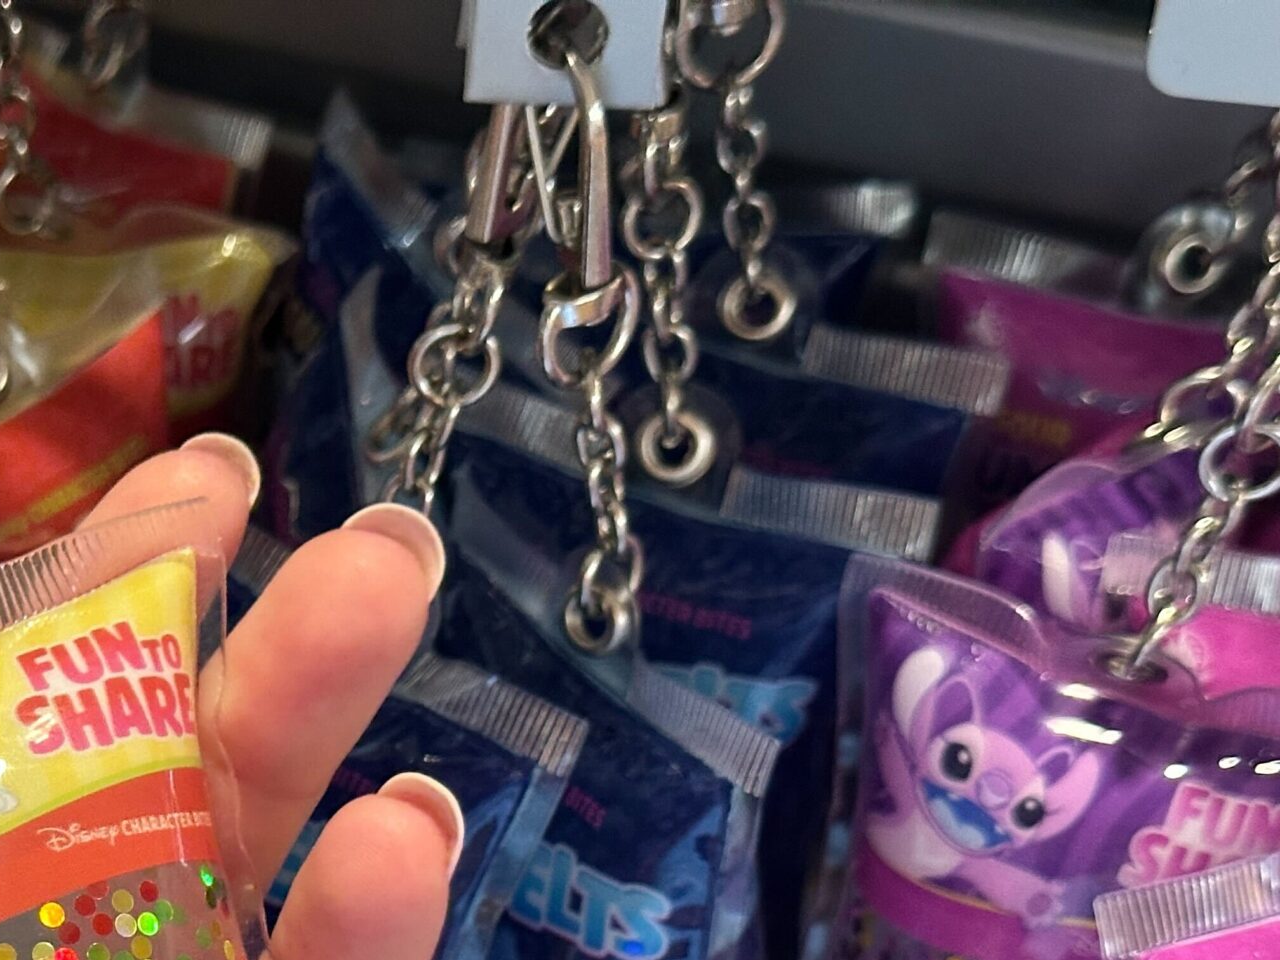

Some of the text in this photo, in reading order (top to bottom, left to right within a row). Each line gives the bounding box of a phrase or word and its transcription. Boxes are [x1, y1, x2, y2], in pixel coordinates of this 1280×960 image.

[16, 620, 183, 692] FUN TO
[15, 672, 197, 755] SHARE
